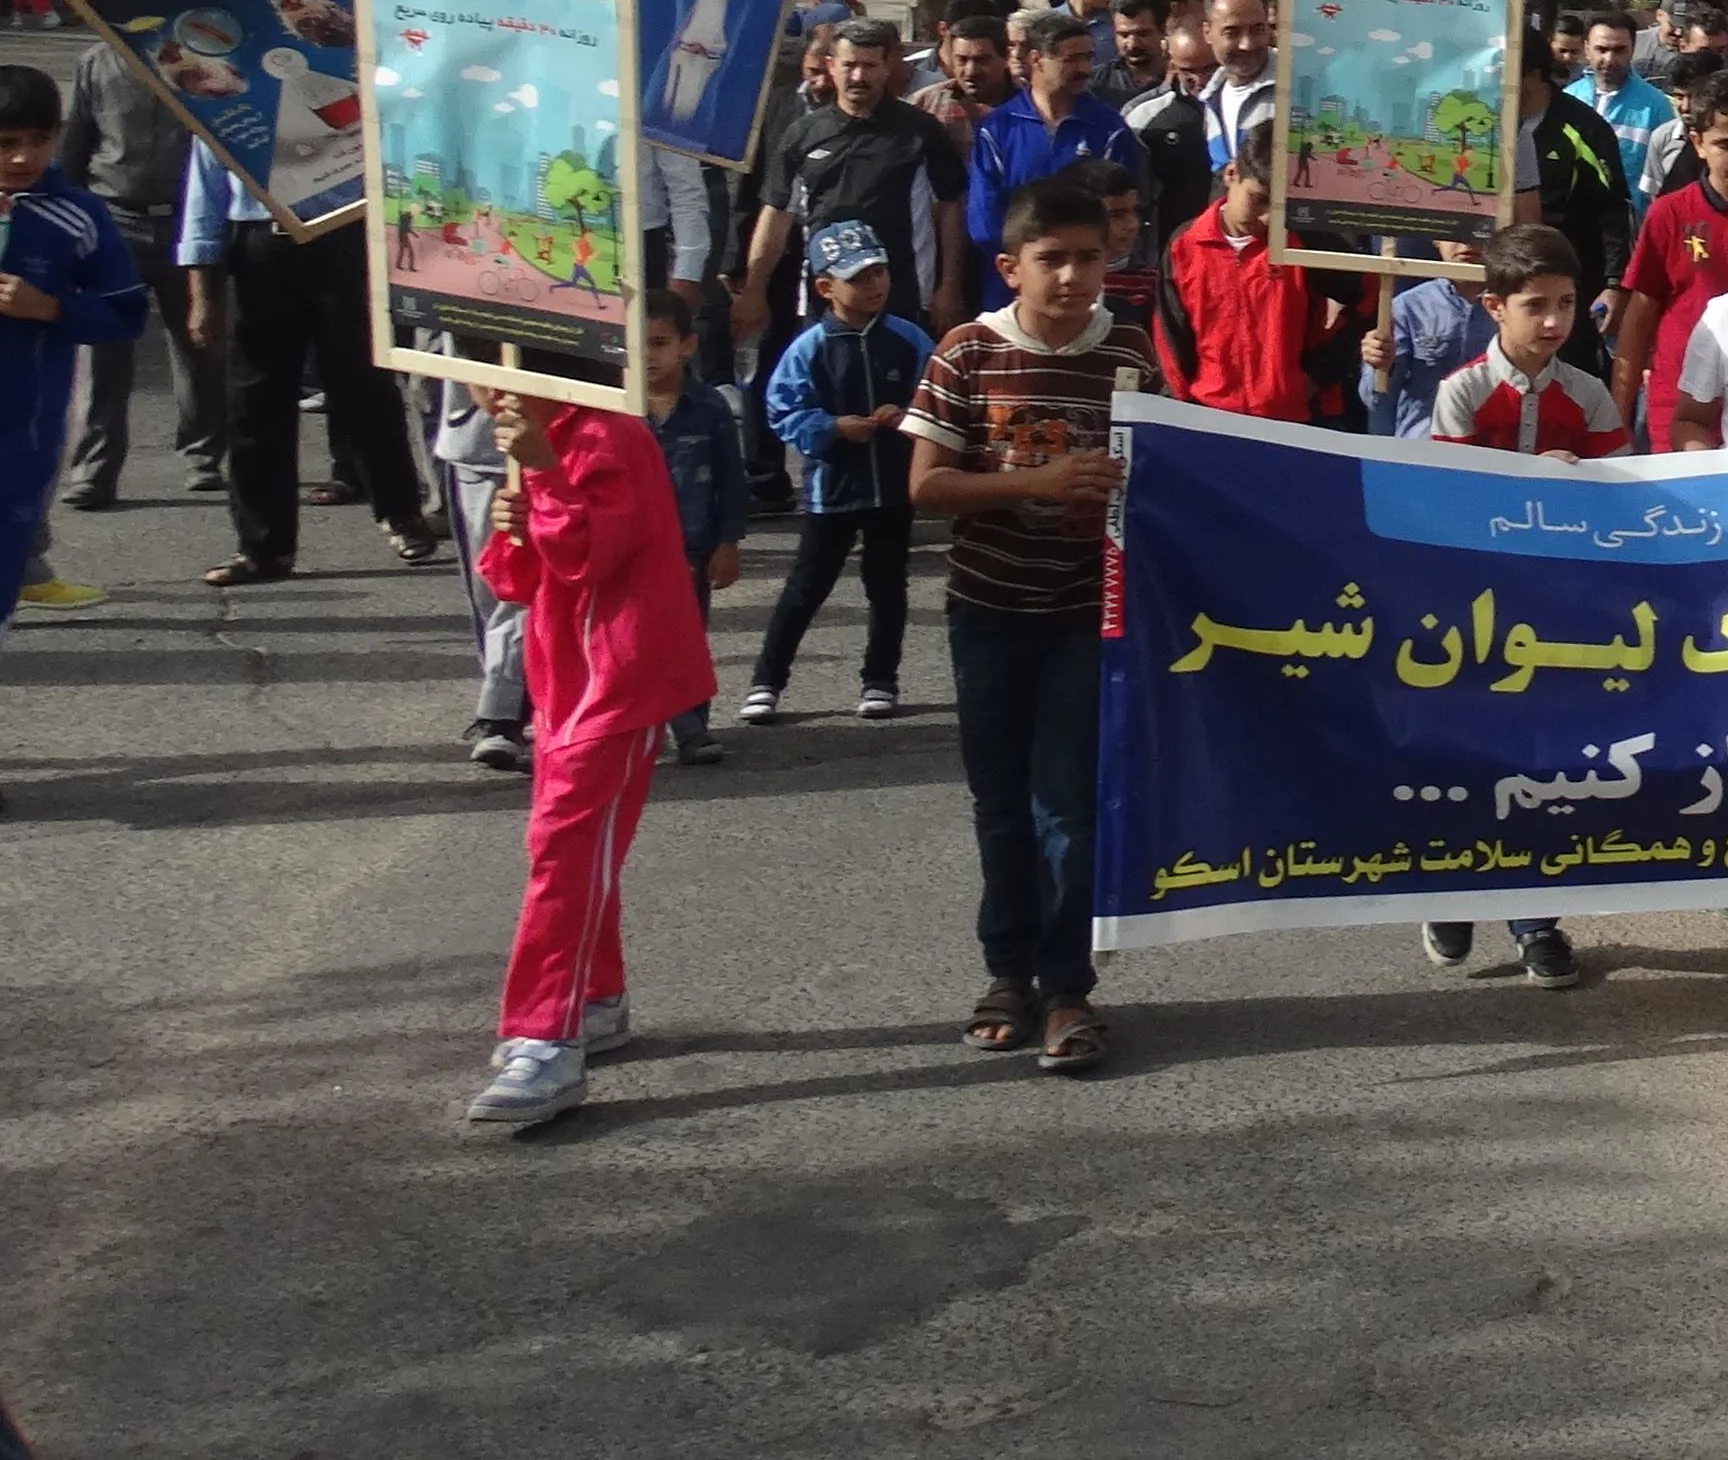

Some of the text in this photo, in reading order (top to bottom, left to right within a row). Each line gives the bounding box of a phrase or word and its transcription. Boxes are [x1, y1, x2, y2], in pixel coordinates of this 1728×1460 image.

[394, 3, 428, 21] سریع
[429, 10, 456, 25] روی
[496, 15, 537, 33] دقیقه
[559, 27, 599, 48] روزانه
[1490, 501, 1587, 538] سالم
[1593, 505, 1722, 548] زندگی
[1171, 583, 1372, 677] شیر
[1397, 589, 1657, 691] لیوان
[1496, 733, 1654, 819] کنیم
[1260, 843, 1409, 886] شهرستان
[1421, 839, 1531, 871] سلامت
[1541, 830, 1690, 875] همگانی
[1699, 841, 1714, 866] و
[1153, 850, 1249, 898] اسکو
